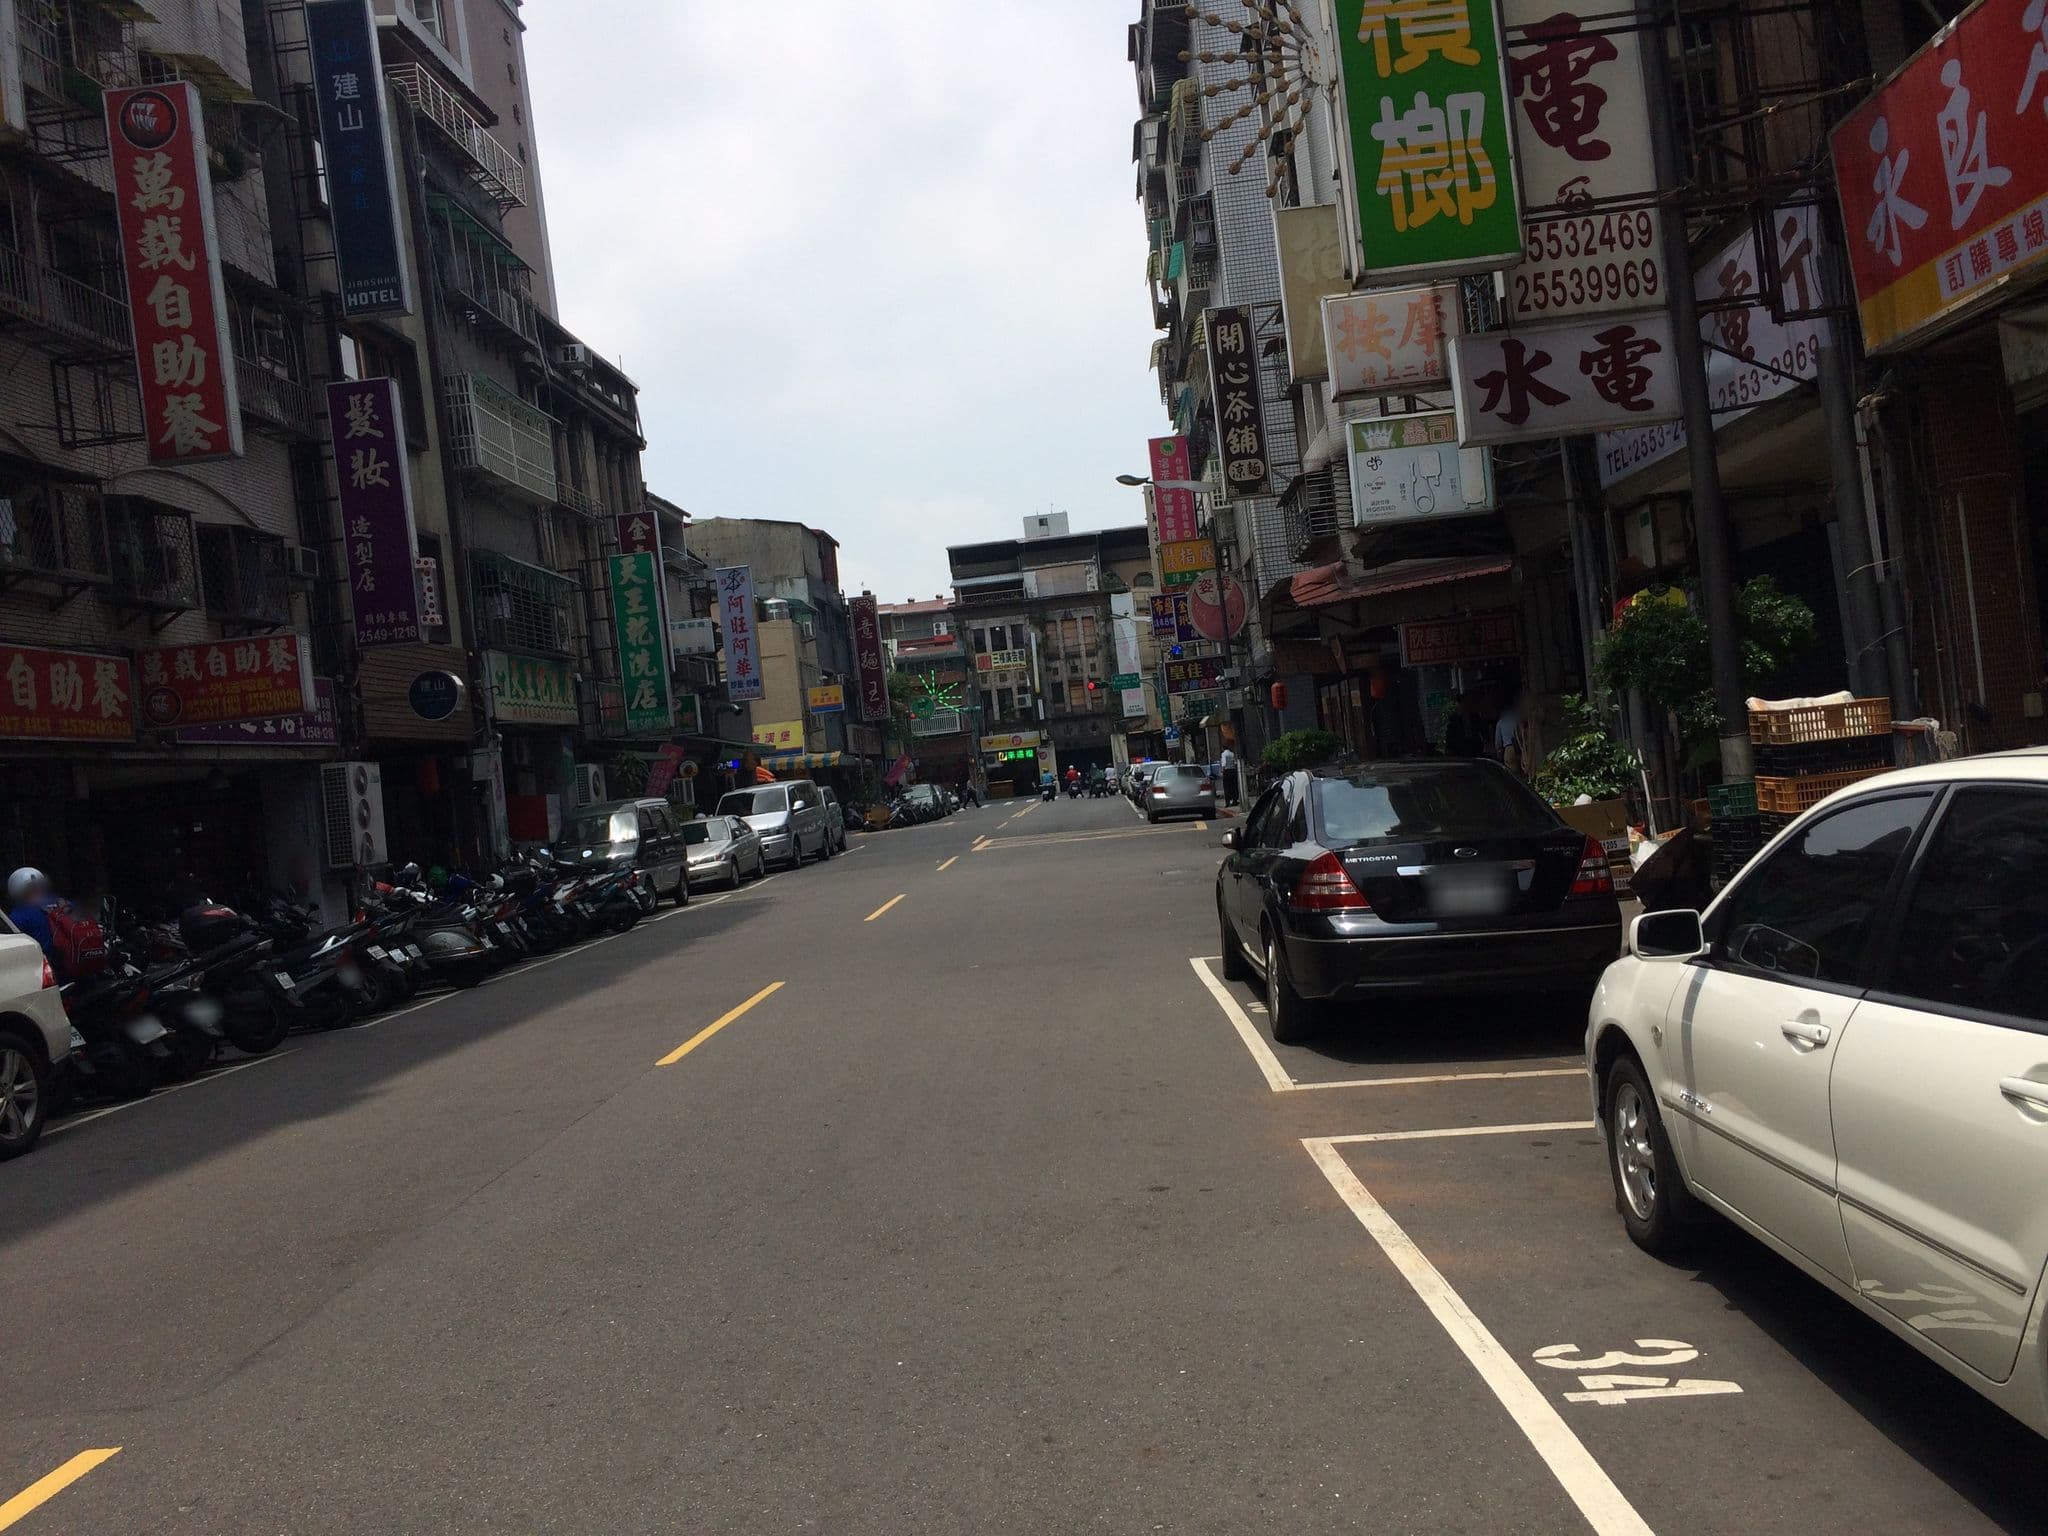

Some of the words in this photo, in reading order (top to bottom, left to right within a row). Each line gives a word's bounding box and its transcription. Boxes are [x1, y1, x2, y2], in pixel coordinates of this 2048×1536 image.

[1509, 12, 1619, 161] 電
[1528, 211, 1653, 263] 5532469
[1945, 209, 2048, 291] 訂購專線
[347, 289, 399, 307] HOTEL
[1516, 258, 1658, 313] 25539969
[1336, 295, 1448, 362] 按摩
[1474, 325, 1661, 425] 水電
[344, 392, 390, 490] 髮妝
[351, 515, 377, 593] 造型店
[359, 625, 418, 643] 2549-1218
[6, 652, 129, 719] 自助餐
[1343, 855, 1399, 865] METROSTAR
